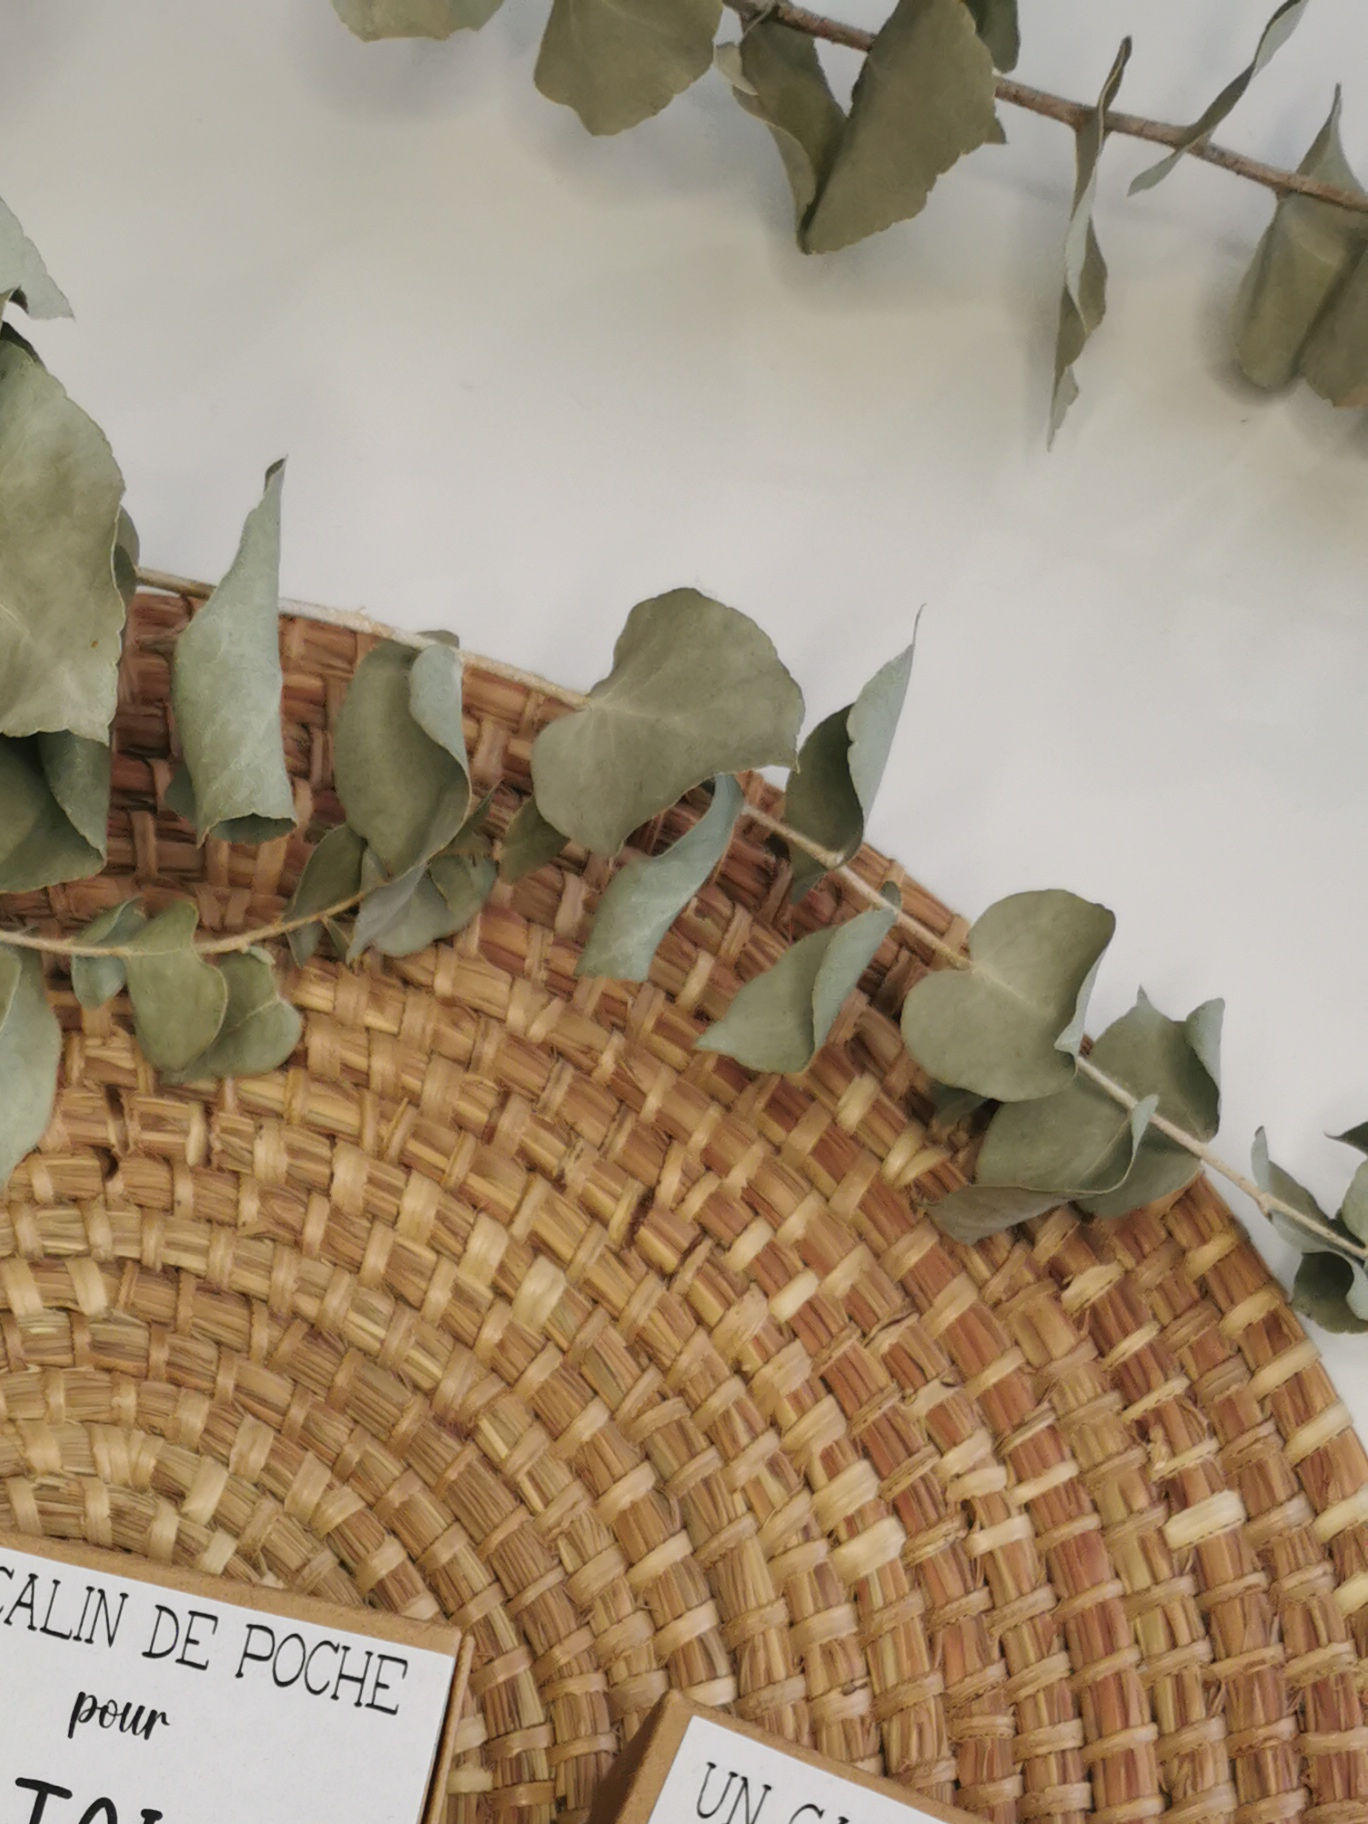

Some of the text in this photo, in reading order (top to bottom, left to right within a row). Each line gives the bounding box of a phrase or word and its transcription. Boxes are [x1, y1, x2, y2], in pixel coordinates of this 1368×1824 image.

[141, 1604, 219, 1671] DE
[234, 1623, 409, 1716] POCHE
[67, 1691, 171, 1741] pour
